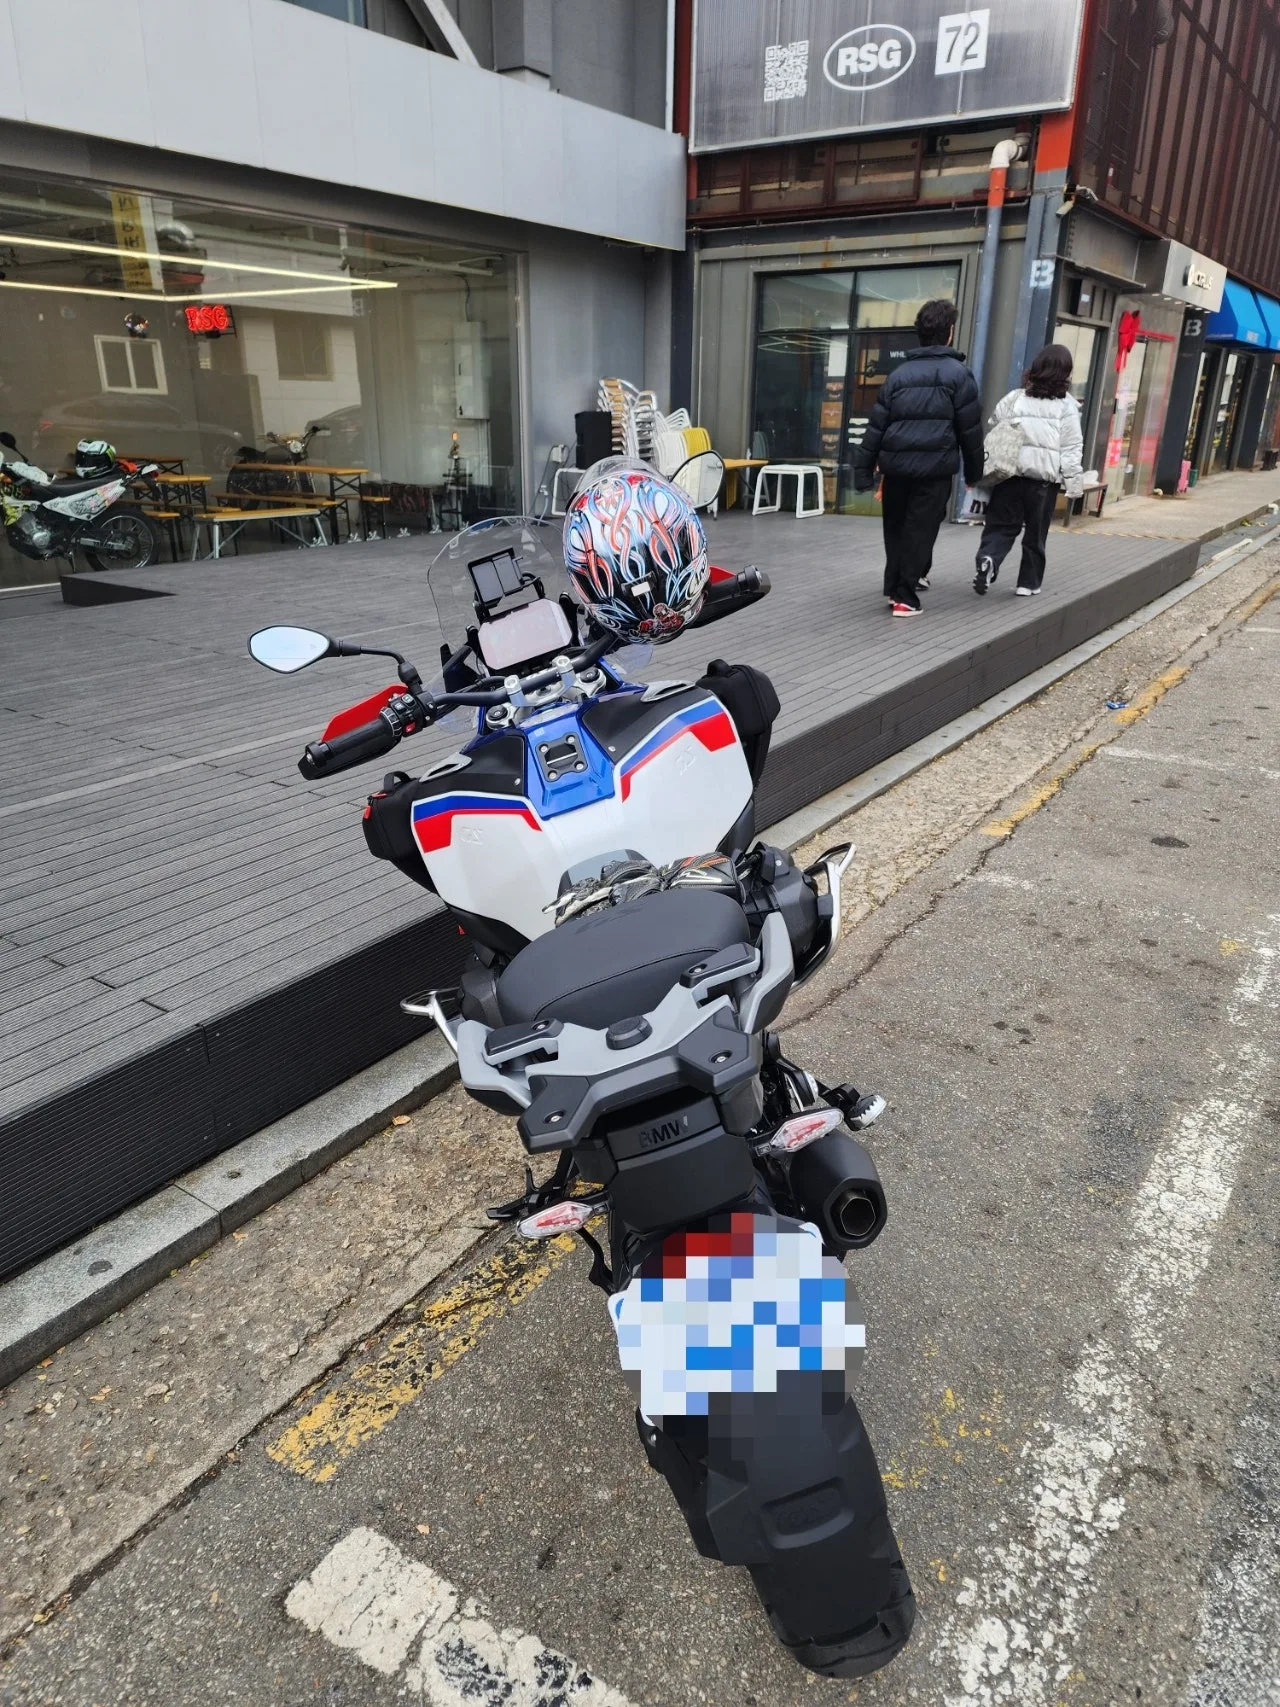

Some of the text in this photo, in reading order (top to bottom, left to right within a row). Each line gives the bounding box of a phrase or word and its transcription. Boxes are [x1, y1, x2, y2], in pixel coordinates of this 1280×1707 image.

[837, 39, 902, 77] RSG
[944, 22, 981, 66] 72
[185, 304, 230, 333] RSG
[639, 1114, 690, 1149] BMW
